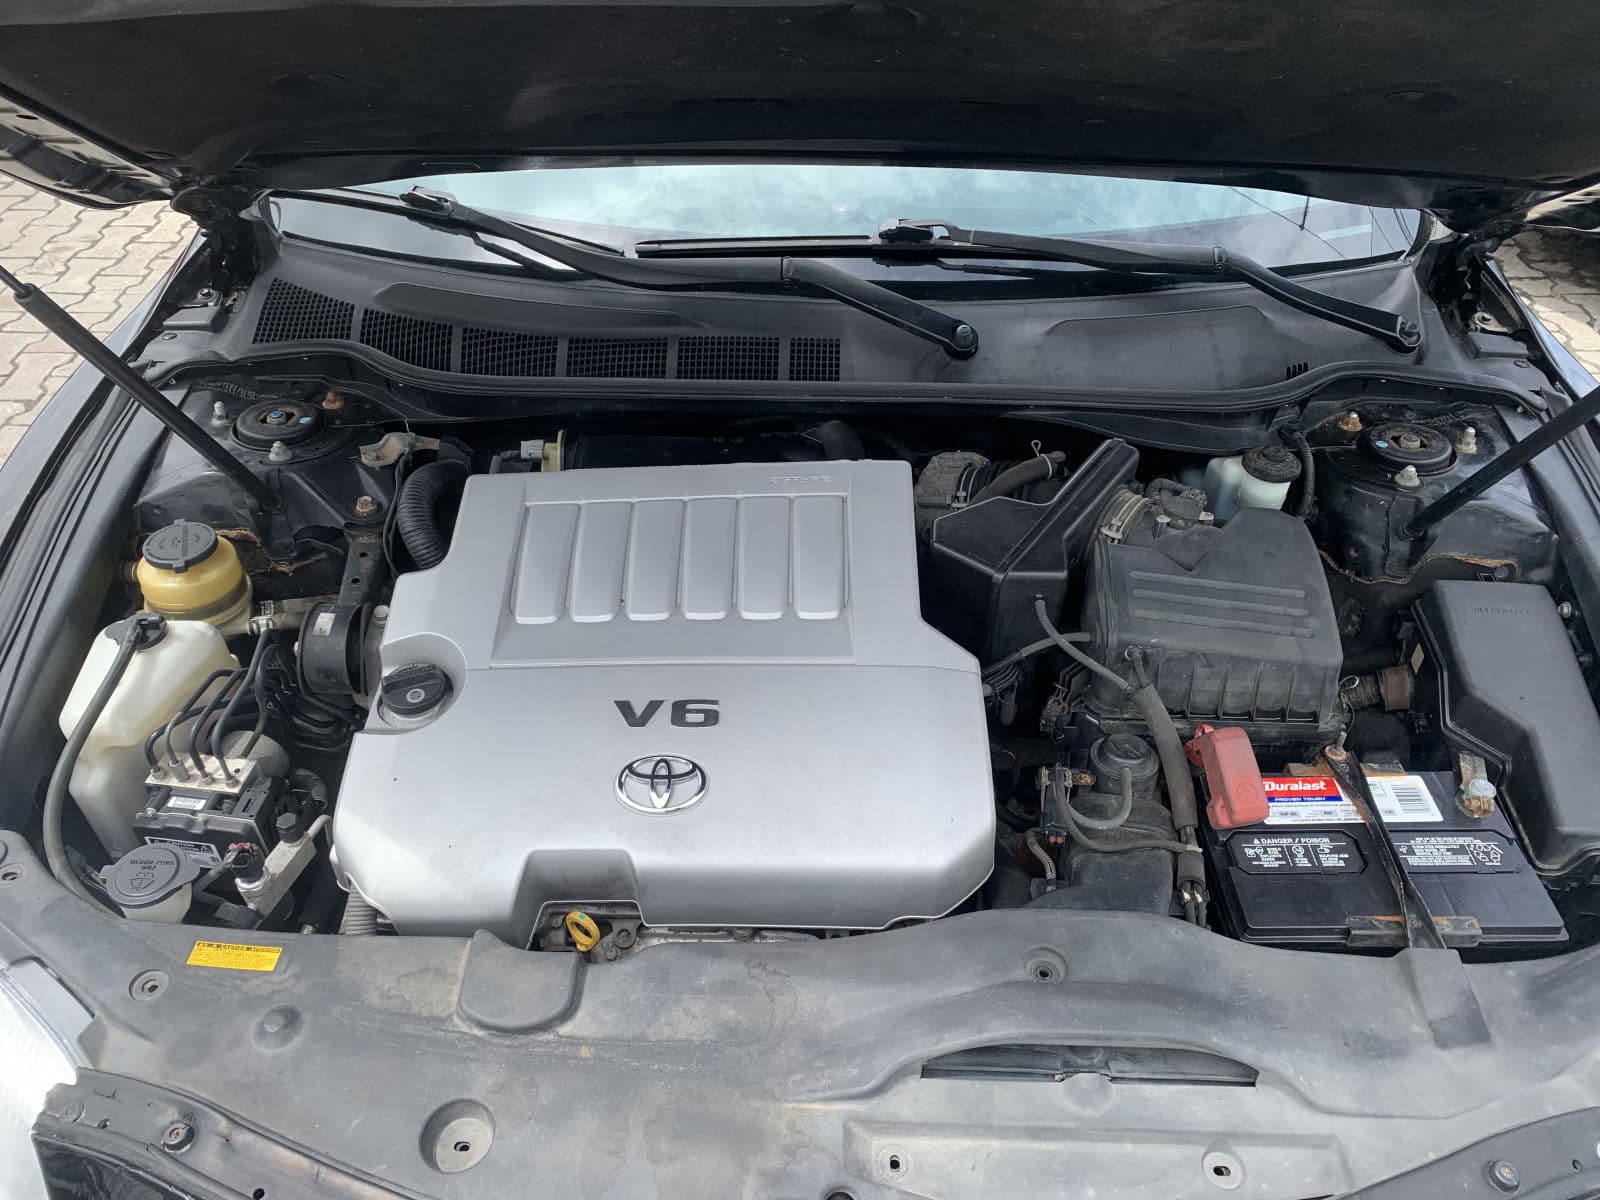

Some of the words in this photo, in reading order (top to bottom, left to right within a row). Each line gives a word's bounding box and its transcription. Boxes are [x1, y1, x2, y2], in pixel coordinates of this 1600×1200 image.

[613, 699, 719, 727] V6
[1263, 780, 1327, 791] Duralast
[1300, 836, 1330, 844] POISON
